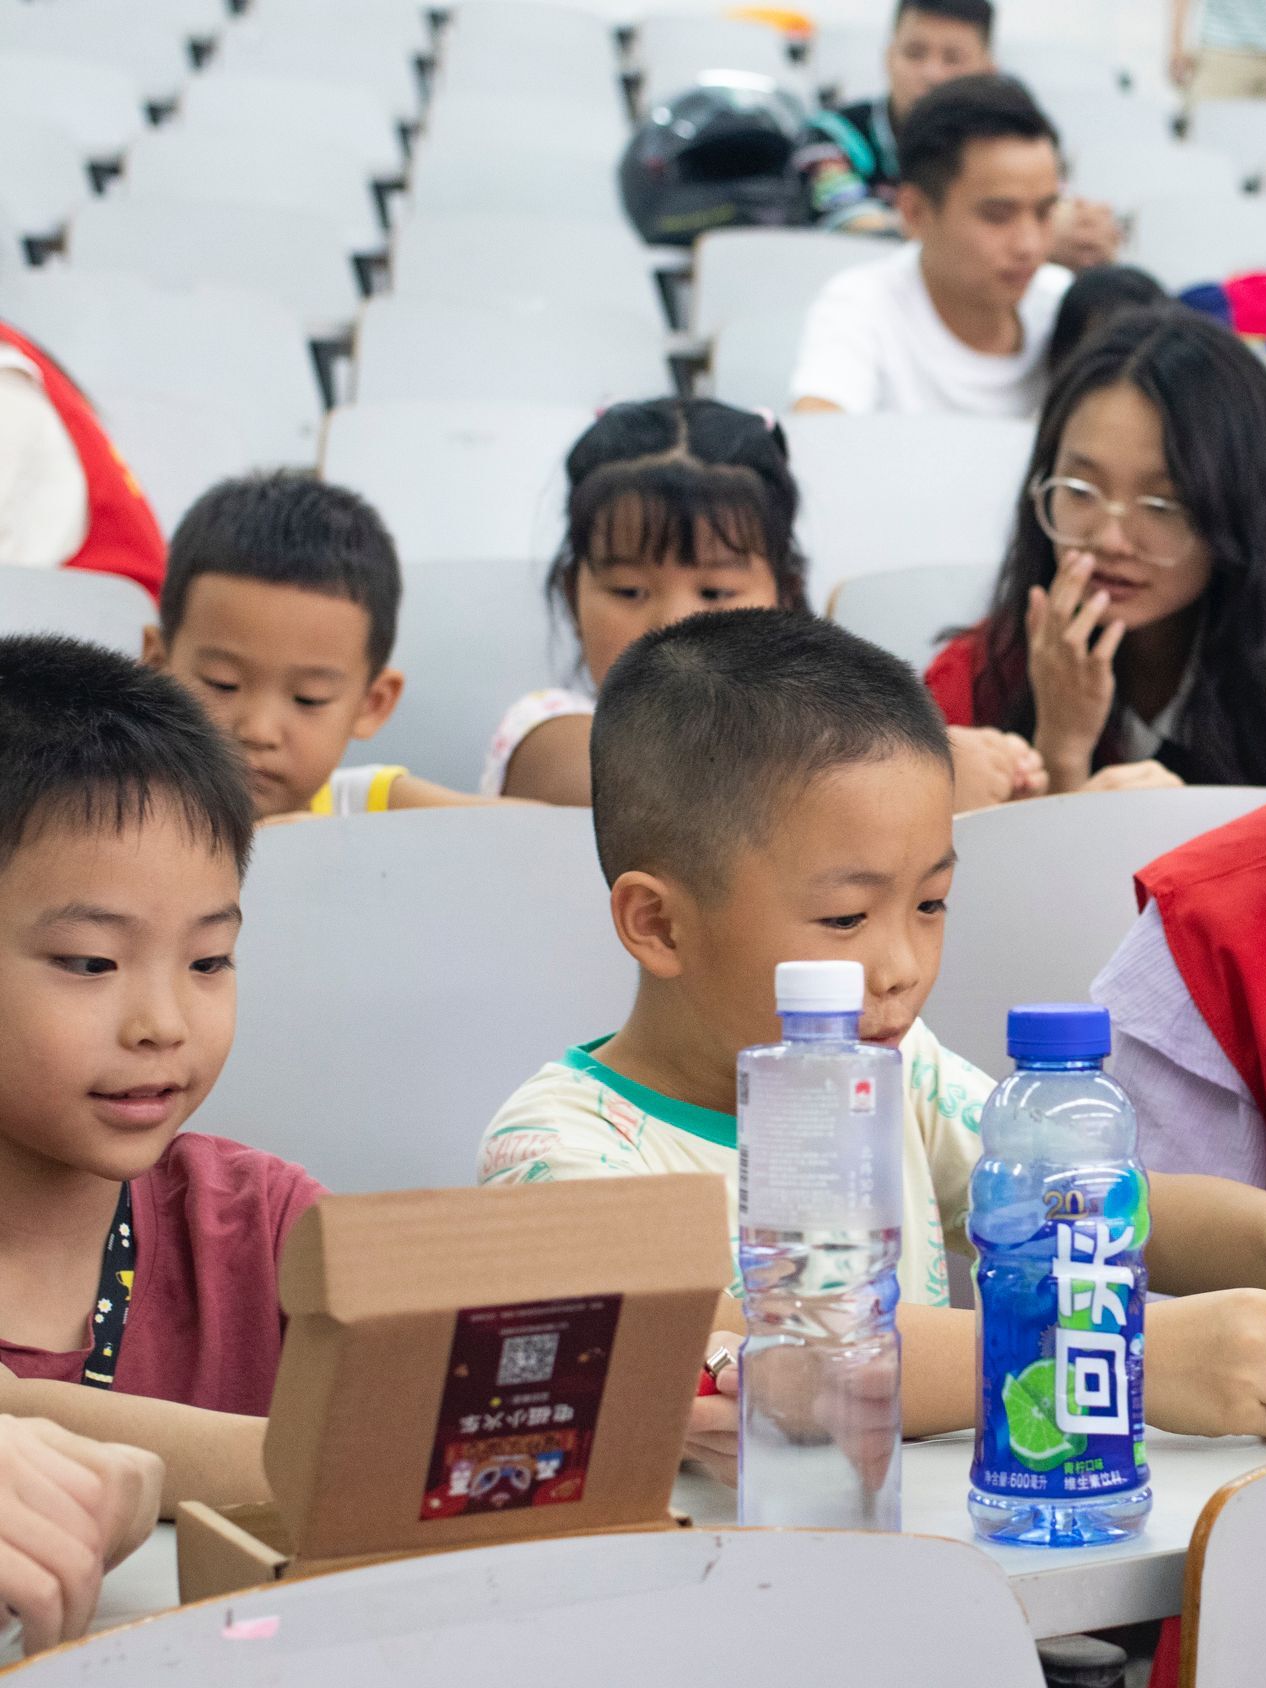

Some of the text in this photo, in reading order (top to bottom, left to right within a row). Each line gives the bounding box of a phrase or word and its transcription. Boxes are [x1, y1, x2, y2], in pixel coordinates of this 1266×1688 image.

[1043, 1189, 1089, 1220] 20
[1052, 1222, 1134, 1435] 回来
[1064, 1469, 1126, 1490] 维生素饮料
